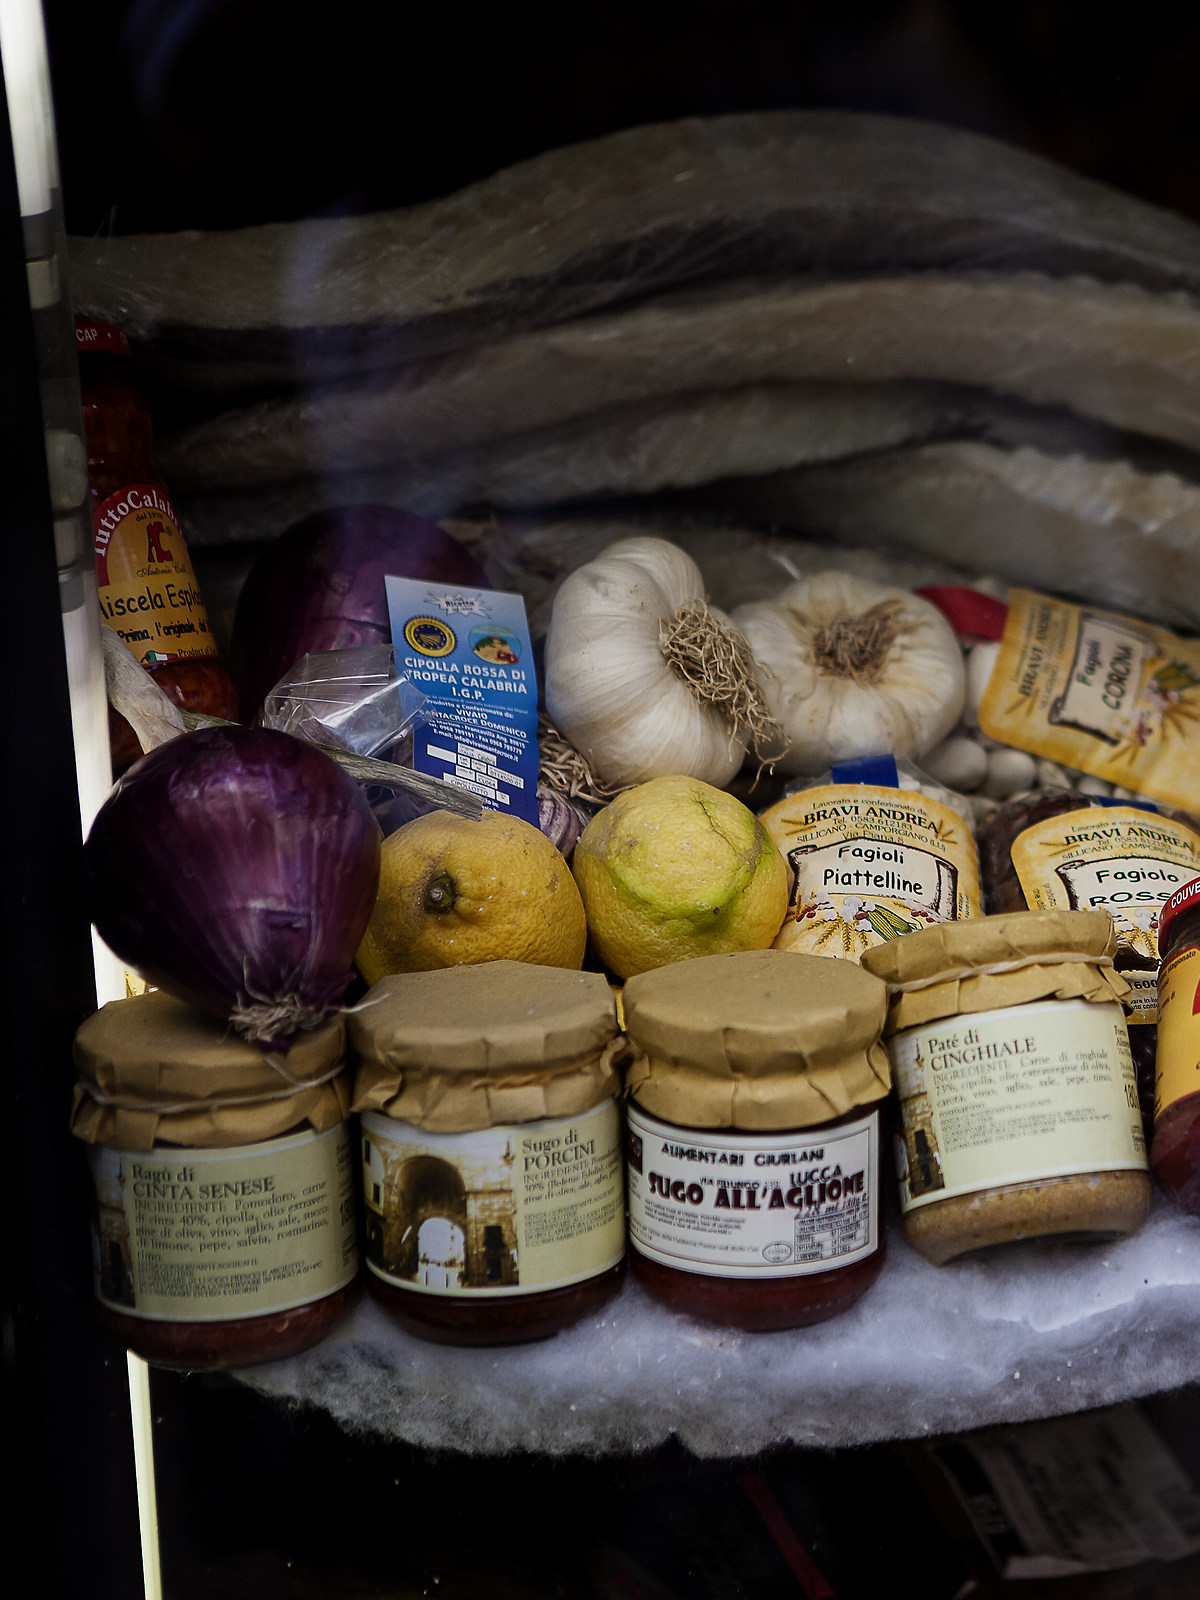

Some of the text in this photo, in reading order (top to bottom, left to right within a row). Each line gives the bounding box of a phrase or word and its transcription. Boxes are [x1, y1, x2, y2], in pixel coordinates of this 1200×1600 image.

[404, 656, 526, 681] CIPOLLA ROSSA DI
[451, 687, 486, 701] I.G.P.
[461, 676, 528, 695] CALABRIA
[455, 708, 489, 720] VIVAIO
[480, 719, 528, 739] DOMENICO
[812, 798, 917, 814] Lavorato confezionato
[803, 805, 940, 834] BRAVI ANDREA
[832, 816, 848, 825] Tel.
[796, 823, 848, 845] SILLICANO
[854, 822, 929, 844] CAMPORGIANO
[1064, 827, 1194, 851] BRAVI ANDREA
[837, 844, 905, 864] Fagioli
[823, 868, 924, 896] Piattelline
[1095, 867, 1180, 884] Fagiolo
[927, 1029, 980, 1054] Paté di
[930, 1037, 1037, 1072] CINGHIALE
[521, 1128, 578, 1155] Sugo di
[523, 1139, 596, 1172] PORCINI
[661, 1142, 825, 1168] ALIMENTARI GIURLANI
[132, 1164, 194, 1185] Ragù di
[789, 1164, 844, 1188] LUCCA
[133, 1176, 276, 1200] CINTA SENESE
[647, 1171, 704, 1206] SUGO
[713, 1170, 865, 1211] ALL'AGLIONE
